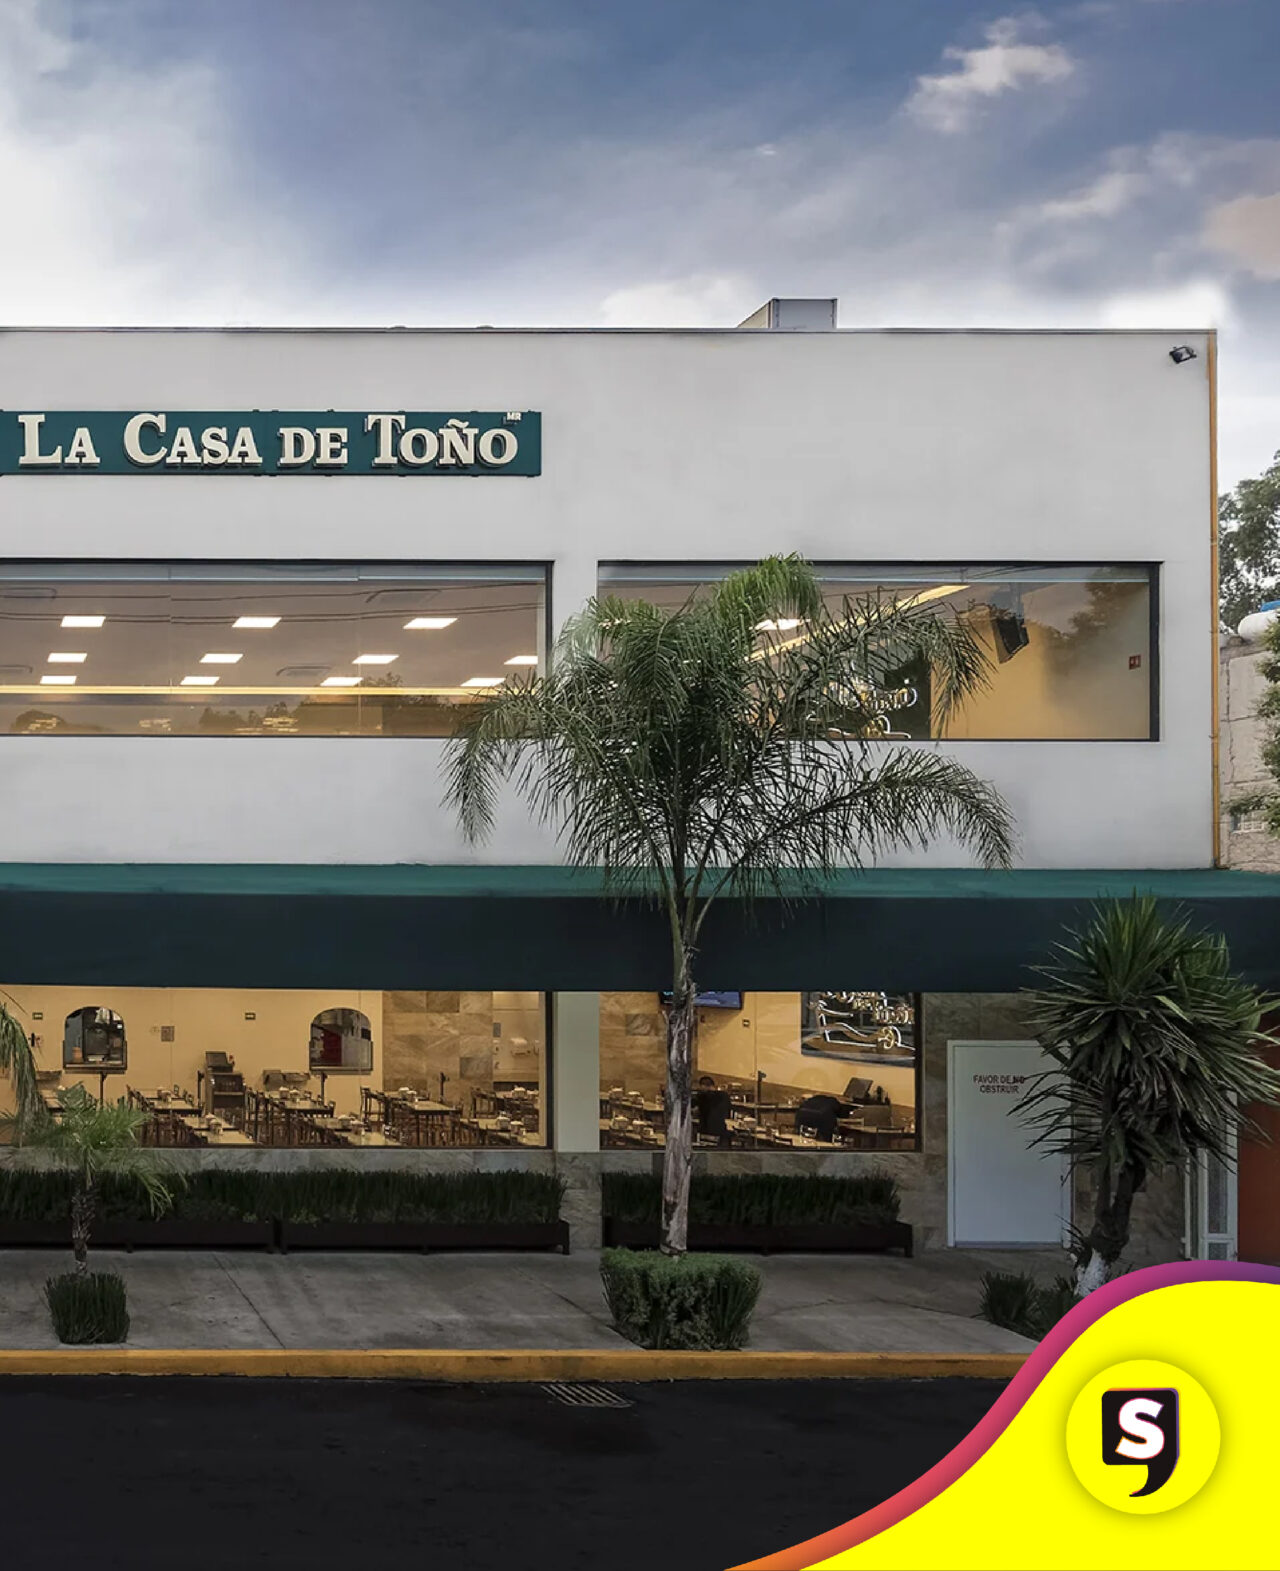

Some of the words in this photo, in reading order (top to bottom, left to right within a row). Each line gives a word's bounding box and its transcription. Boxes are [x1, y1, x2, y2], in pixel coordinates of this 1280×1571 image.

[18, 413, 101, 465] LA
[123, 412, 263, 466] CASA
[278, 427, 349, 465] DE
[366, 413, 519, 466] TOÑO
[973, 1074, 999, 1085] FAVOR
[1000, 1074, 1013, 1084] DE
[979, 1085, 1020, 1094] OBSTRUIR
